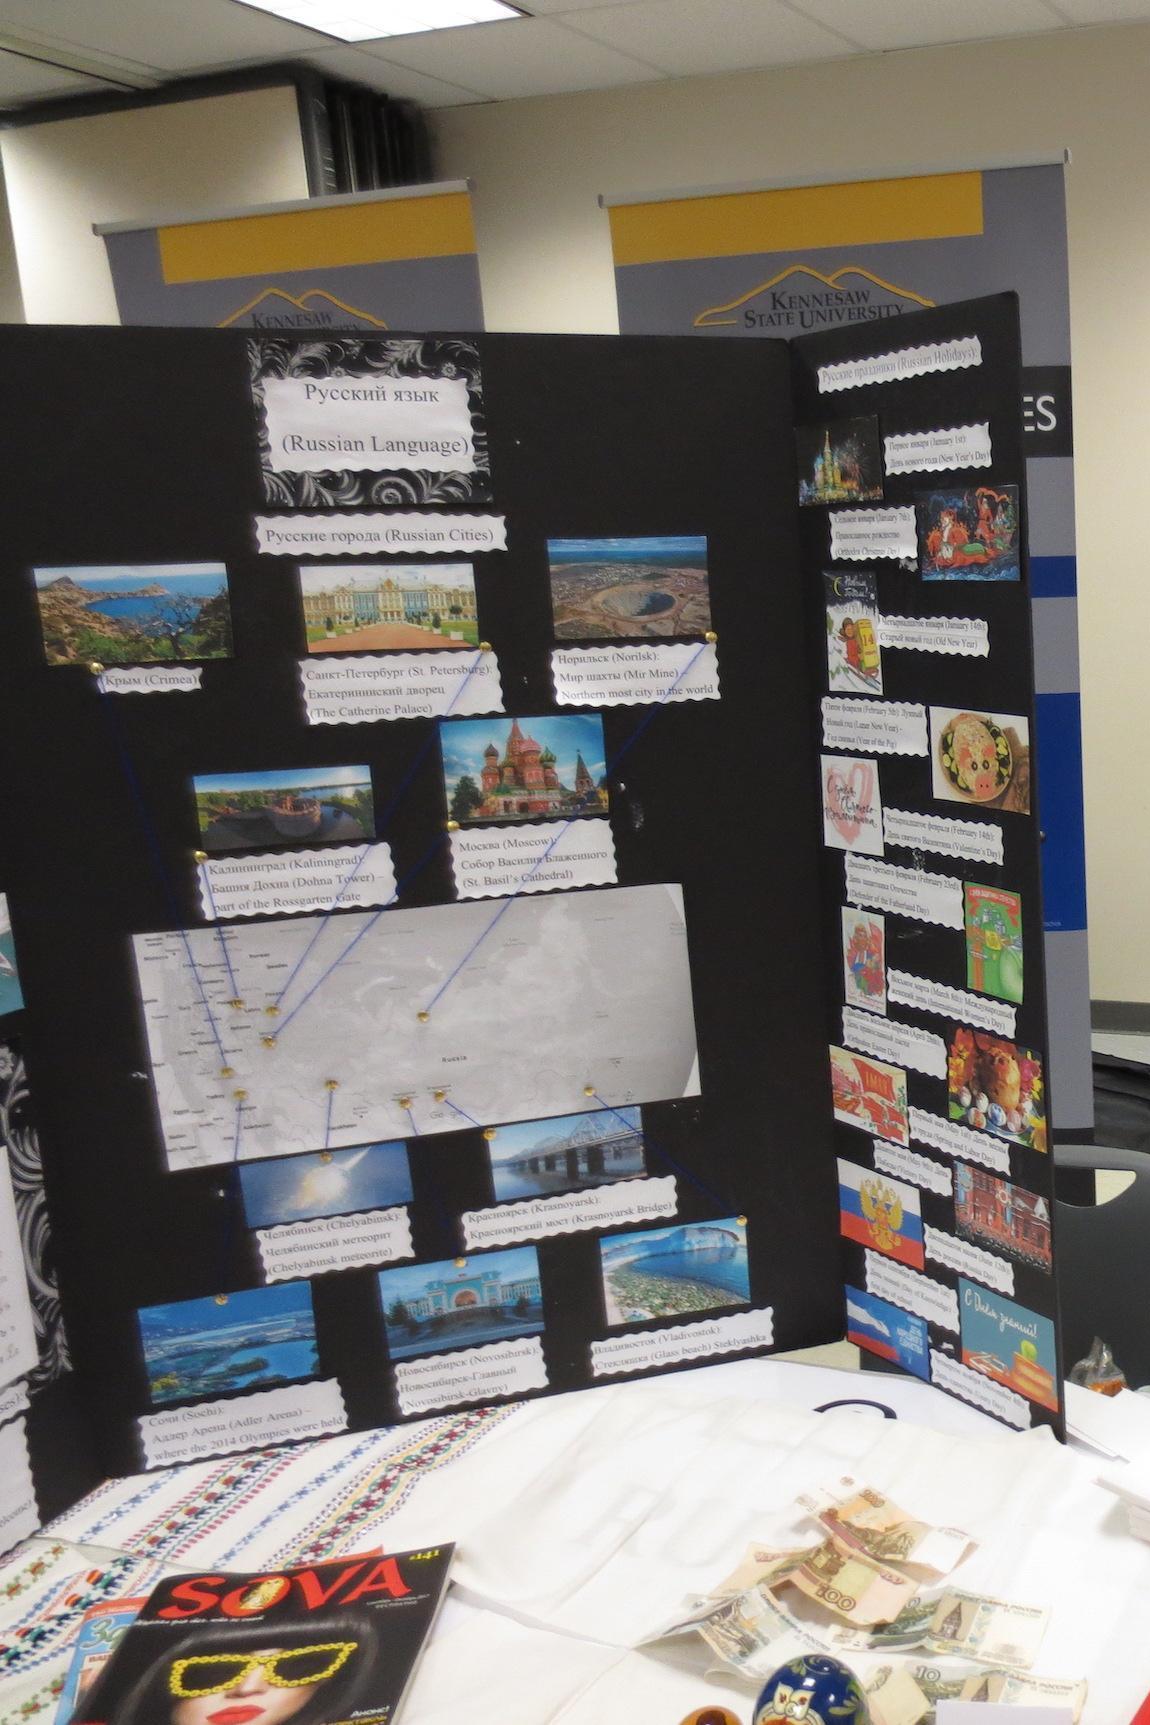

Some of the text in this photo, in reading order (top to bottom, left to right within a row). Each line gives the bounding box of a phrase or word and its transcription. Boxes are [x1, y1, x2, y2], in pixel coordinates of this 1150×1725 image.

[771, 290, 870, 311] KENNESAW
[744, 309, 794, 329] STATE
[897, 355, 932, 372] (Russian
[305, 383, 439, 404] Русский язык
[282, 434, 469, 457] (Russian Language)
[266, 528, 494, 544] Русские города (Russian Cities)
[558, 655, 609, 667] Норильск
[105, 674, 198, 687] Крым (Crimea)
[306, 667, 404, 683] Санкт-Петербург
[560, 668, 679, 684] Мир шахты (Mir Mine)
[308, 685, 445, 701] Екатерининский дворец
[561, 684, 714, 701] Northern most city in the world
[310, 703, 433, 720] (The Catherine Palace)
[459, 841, 500, 853] Москва
[208, 862, 287, 876] Калининград
[461, 859, 495, 872] Собор
[211, 882, 250, 894] Башня
[292, 875, 333, 890] (Dohna
[336, 873, 375, 887] Tower)
[484, 873, 518, 886] Basil's
[521, 870, 574, 883] Cathedral)
[238, 899, 250, 910] of
[252, 898, 270, 910] the
[273, 893, 333, 910] Rossgarten
[468, 1208, 528, 1225] Красноярск
[469, 1201, 673, 1240] Красноярский мост (Krasnoyarsk Bridge)
[263, 1225, 324, 1240] Челябинск
[342, 1231, 392, 1247] метеорит
[269, 1247, 393, 1277] (Chelyabinsk meteorite)
[651, 1350, 679, 1363] (Glass
[681, 1341, 712, 1356] beach)
[398, 1361, 469, 1378] Новосибирск
[149, 1415, 179, 1428] Сочи
[152, 1408, 302, 1445] Адлер Арена (Adler Arena)
[153, 1415, 344, 1462] where the 2014 Olympics were held
[157, 1556, 413, 1619] SOVA
[815, 1582, 857, 1612] 100
[916, 1665, 941, 1683] 10
